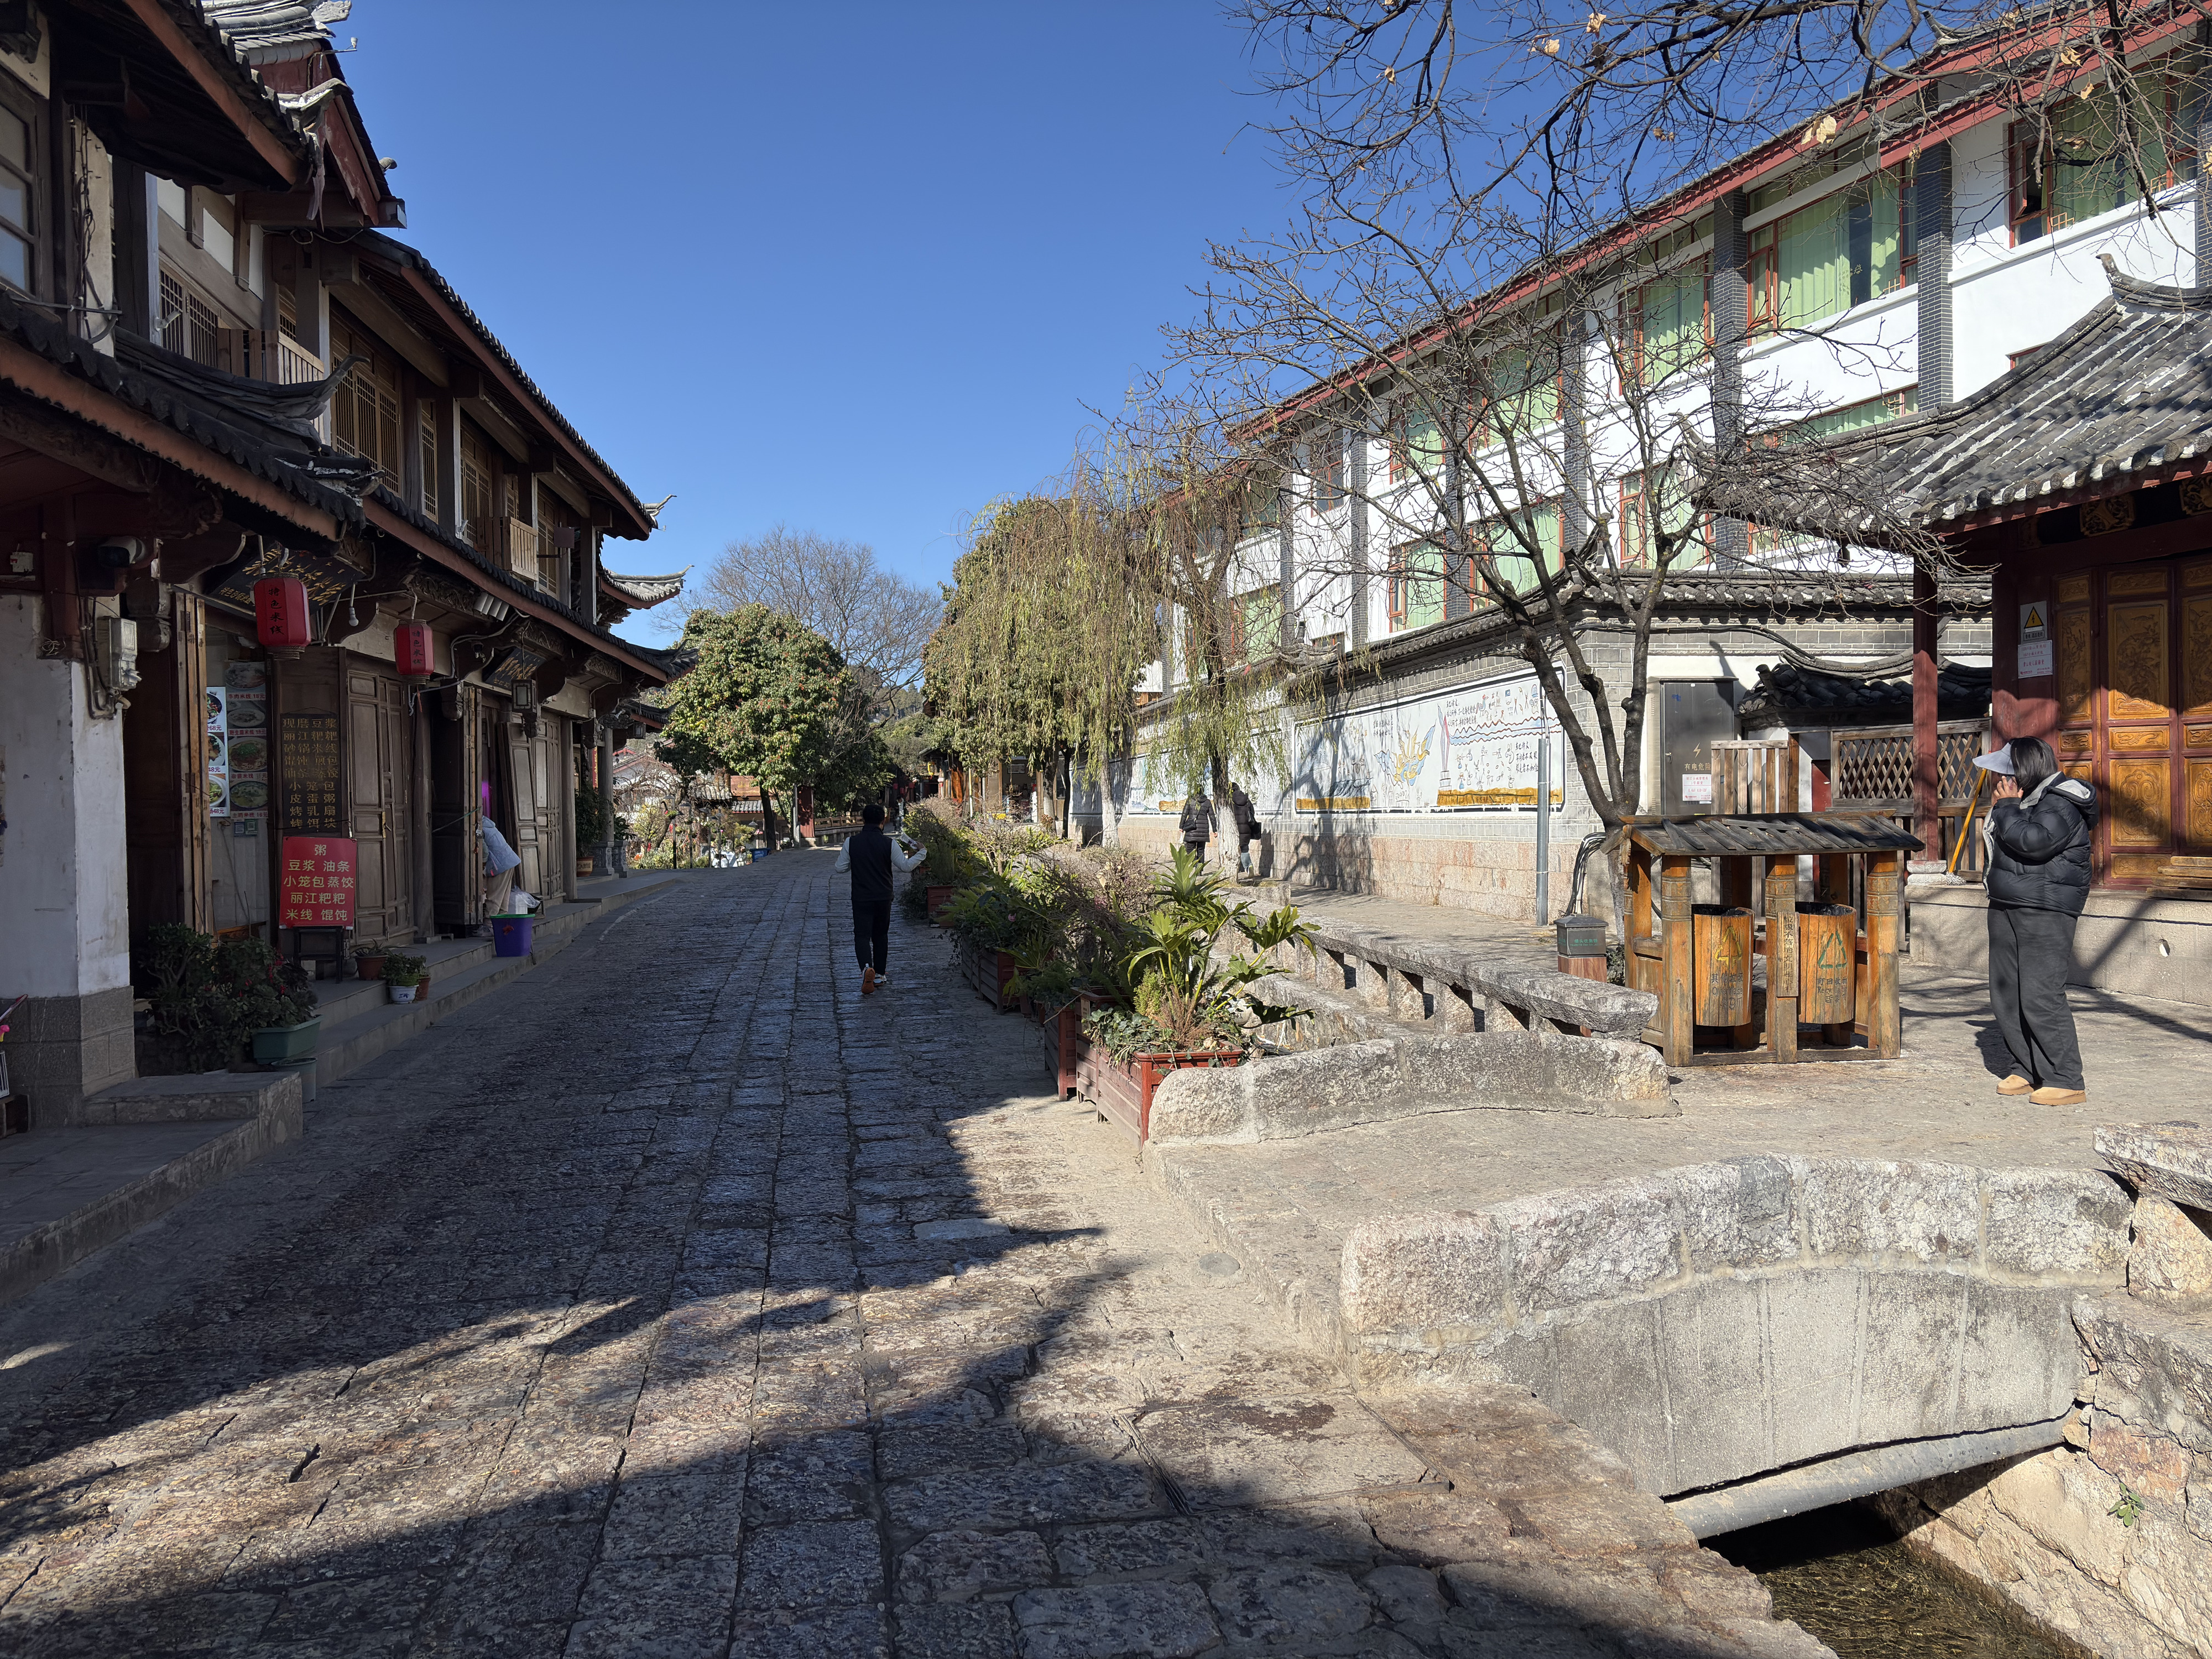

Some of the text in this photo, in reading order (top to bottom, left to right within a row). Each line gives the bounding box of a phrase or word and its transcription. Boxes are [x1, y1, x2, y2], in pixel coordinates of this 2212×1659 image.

[283, 718, 337, 728] 现磨豆浆
[283, 731, 338, 741] 丽江粑粑
[284, 743, 337, 754] 砂锅米线
[1684, 763, 1712, 771] 有电危险
[289, 781, 335, 791] 小笼包
[290, 793, 336, 804] 皮蛋粥
[290, 806, 336, 816] 烤乳扇
[290, 818, 337, 828] 烤饵块
[314, 844, 327, 856] 粥
[288, 859, 350, 872] 豆浆 油条
[283, 875, 354, 888] 小笼包 蒸饺
[290, 892, 346, 905] 丽江粑粑
[285, 908, 348, 921] 米线 馄饨
